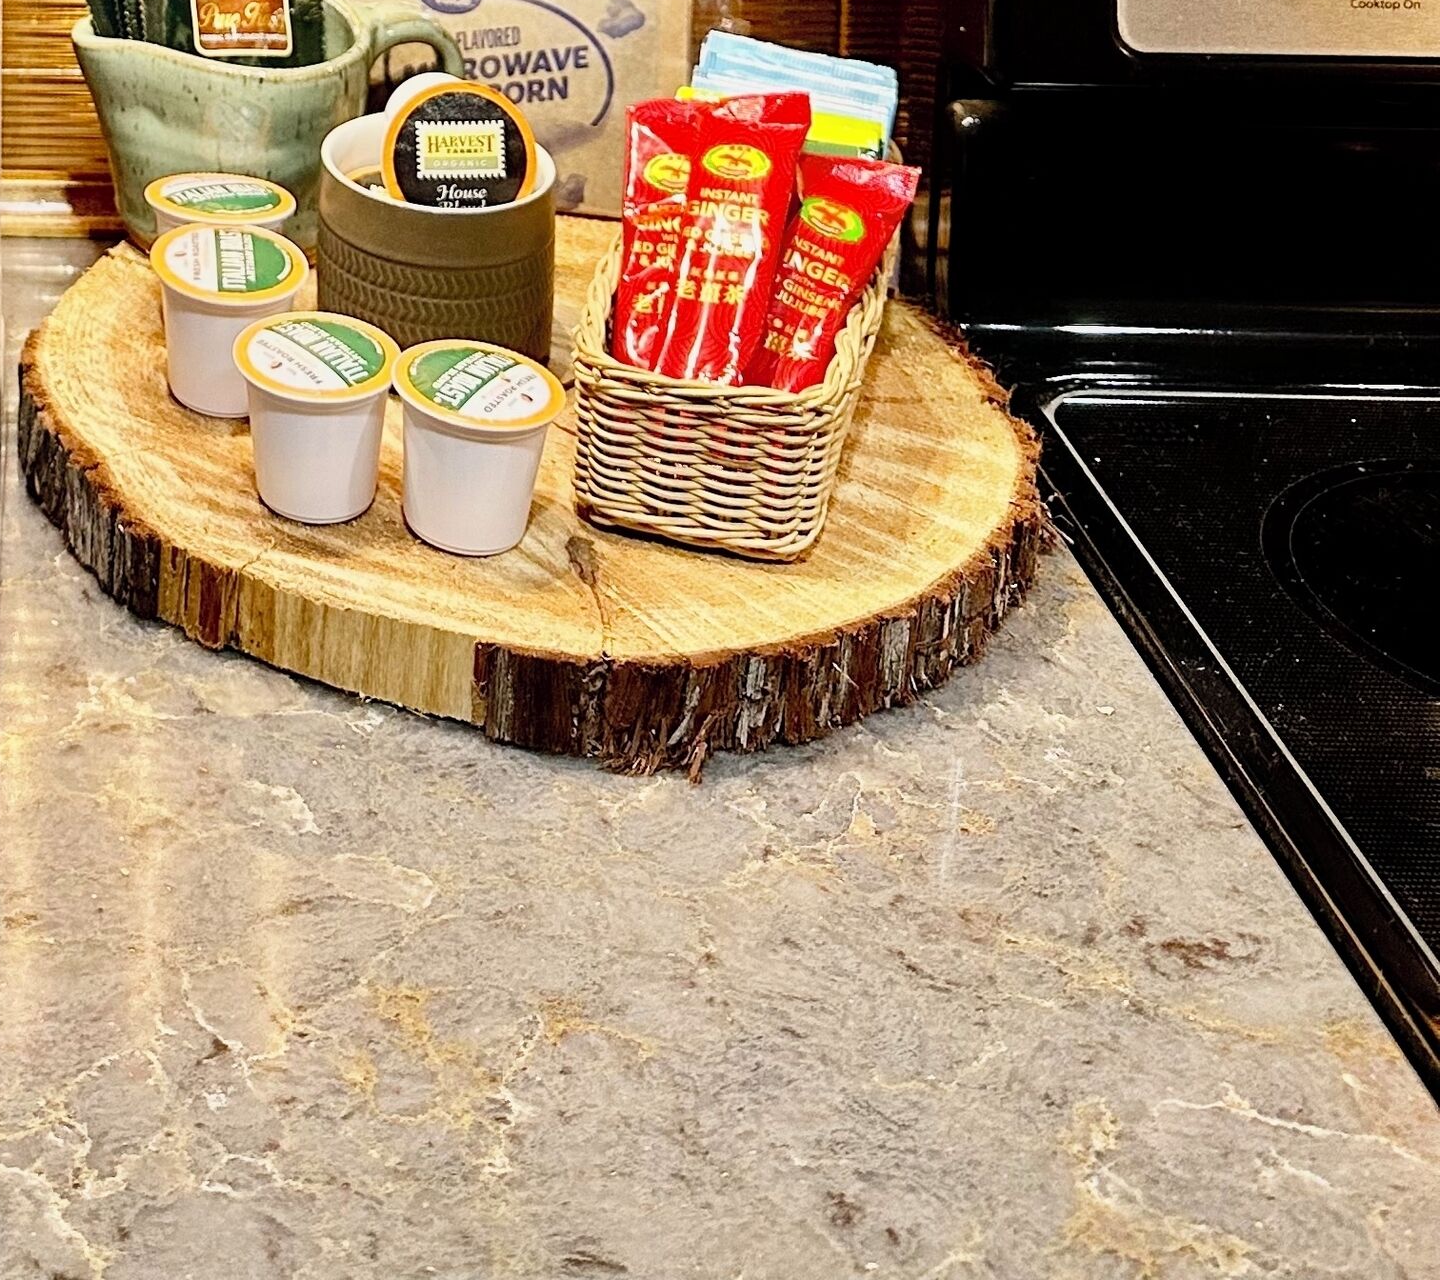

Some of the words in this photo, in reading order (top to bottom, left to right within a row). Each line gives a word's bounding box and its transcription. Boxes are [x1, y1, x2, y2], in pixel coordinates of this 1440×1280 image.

[427, 134, 494, 153] HARVEST
[433, 159, 488, 168] ORGANIC
[436, 184, 488, 201] House
